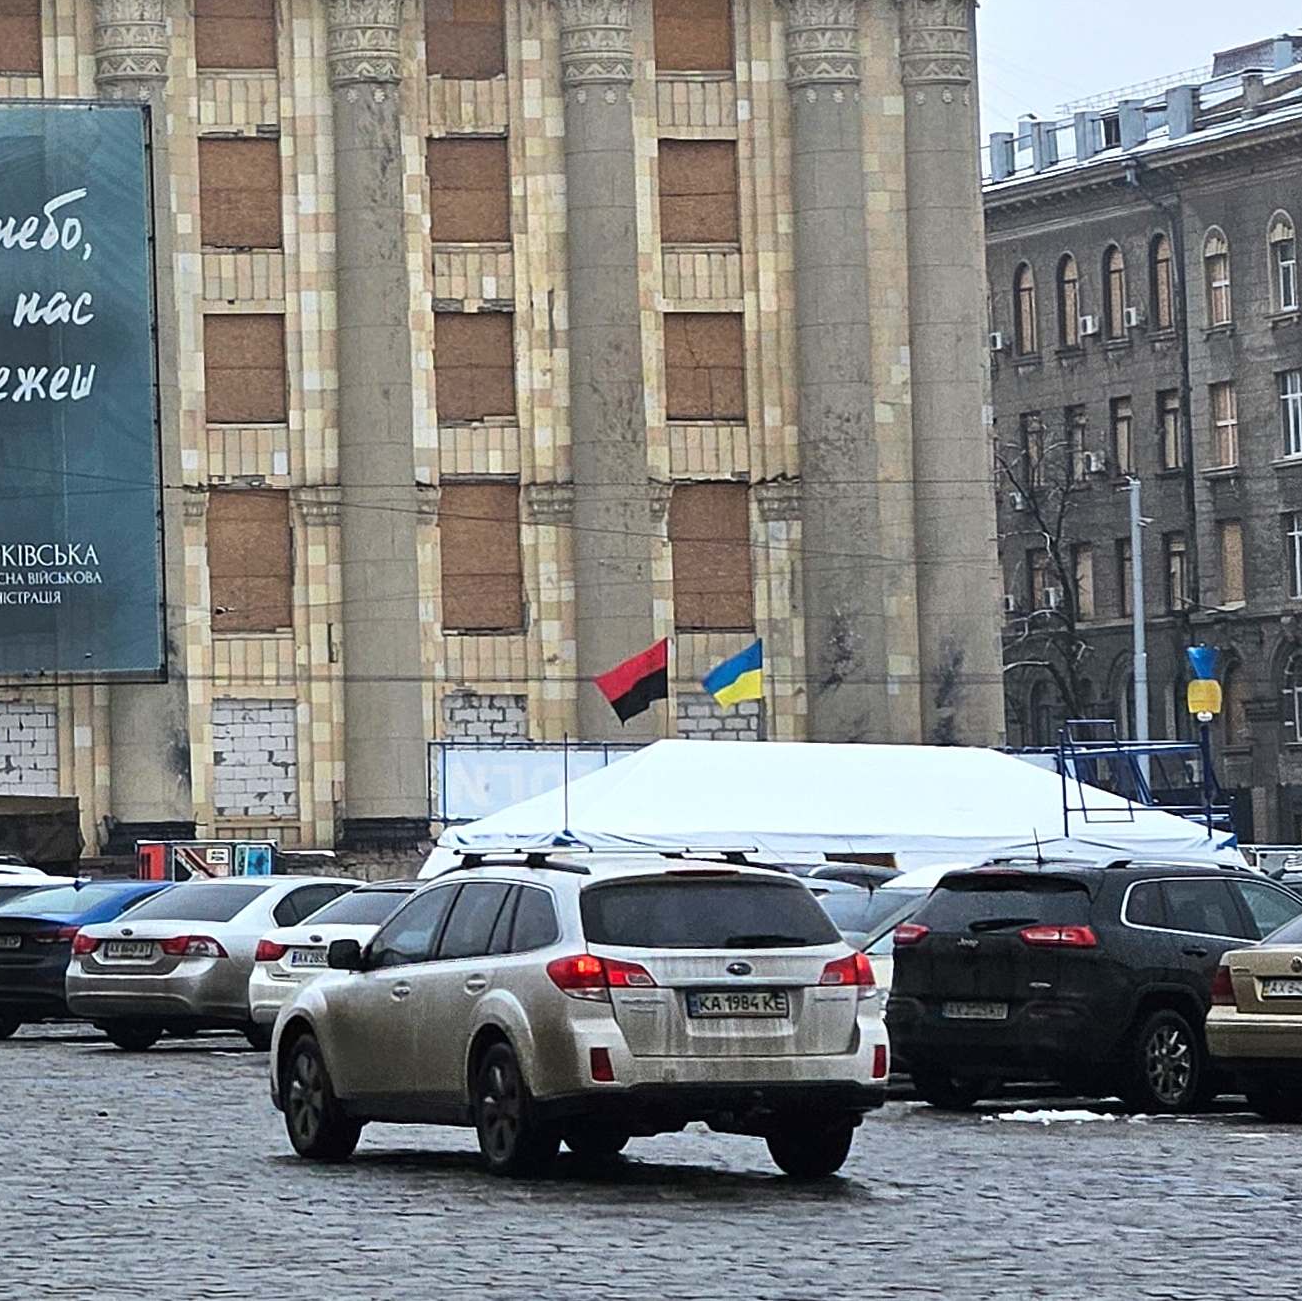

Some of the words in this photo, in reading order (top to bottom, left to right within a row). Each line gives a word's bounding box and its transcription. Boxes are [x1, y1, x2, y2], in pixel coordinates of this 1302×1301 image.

[12, 290, 94, 329] нас
[27, 570, 102, 585] ВІЙСЬКОВА
[699, 996, 722, 1011] KA
[725, 995, 759, 1011] 1984
[762, 994, 787, 1011] KE
